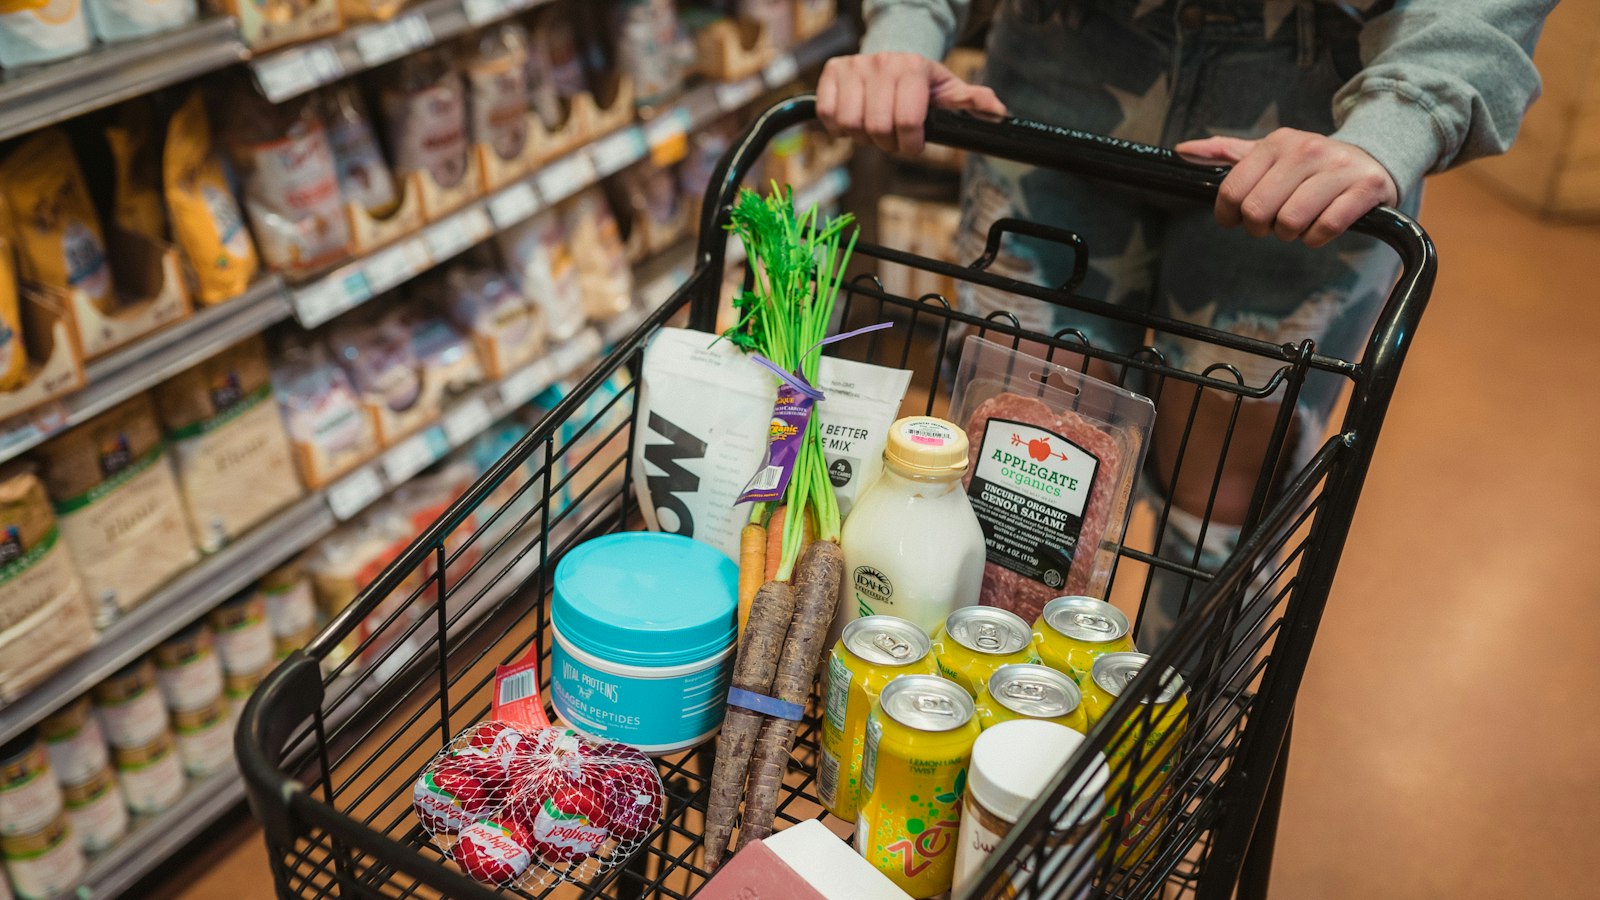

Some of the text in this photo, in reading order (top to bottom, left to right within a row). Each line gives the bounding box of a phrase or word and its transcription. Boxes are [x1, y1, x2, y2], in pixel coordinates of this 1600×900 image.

[826, 424, 868, 440] BETTER
[829, 439, 851, 452] MIX
[991, 449, 1078, 491] APPLEGATE
[1001, 467, 1061, 497] organics
[981, 491, 1066, 532] GENOA SALAMI
[984, 483, 1068, 521] UNCURED ORGANIC
[984, 537, 996, 547] NET
[1019, 552, 1039, 566] (113g)
[856, 574, 890, 596] IDAHO
[563, 660, 580, 682] VITAL
[582, 673, 619, 703] PROTEINS
[553, 676, 588, 712] COLLAGEN
[589, 706, 641, 726] PEPTIDES
[909, 757, 943, 767] LEMON
[909, 766, 937, 775] TWIST
[465, 827, 522, 859] Babybel
[546, 825, 606, 850] Babybel
